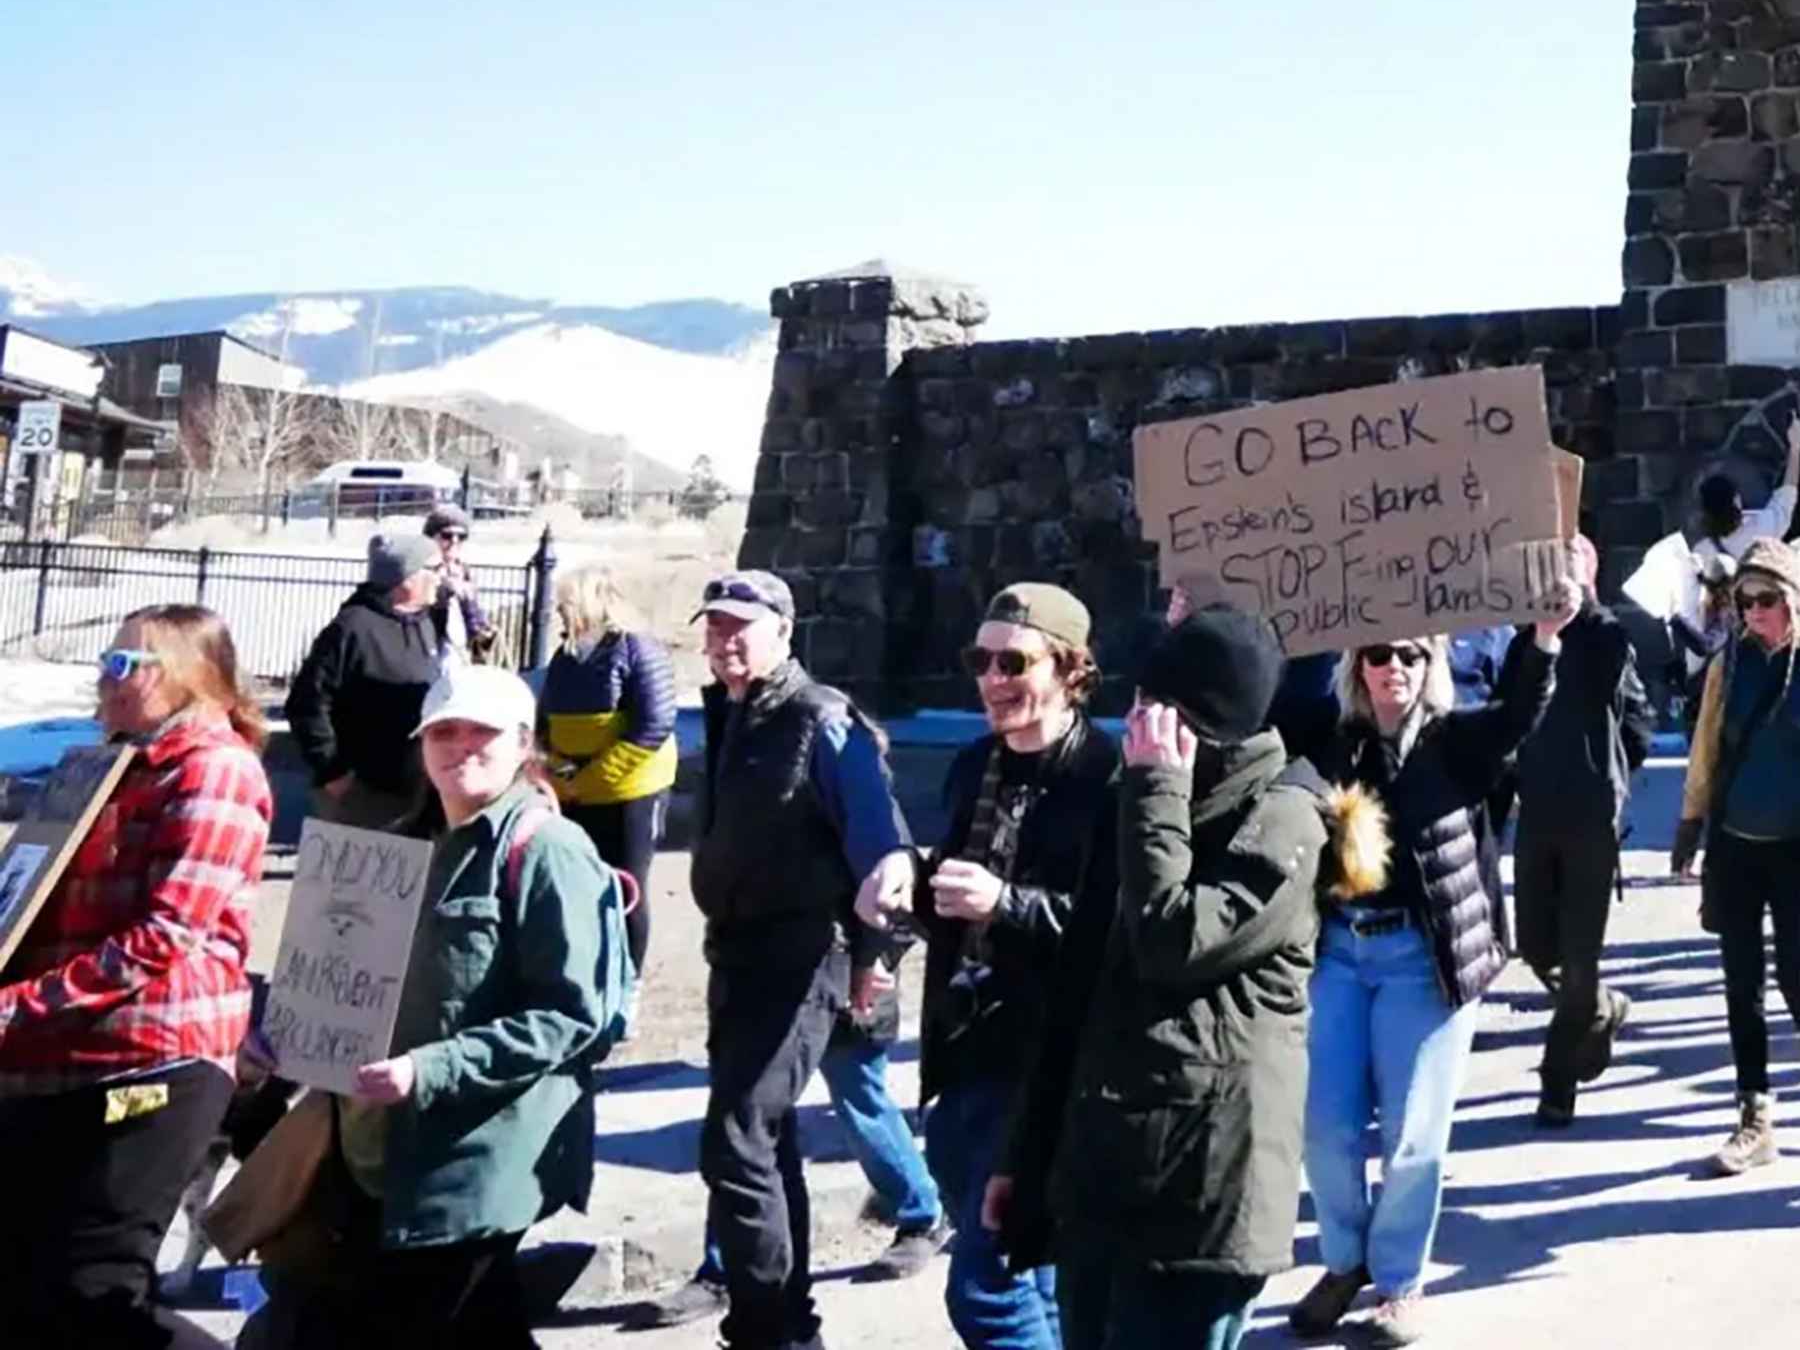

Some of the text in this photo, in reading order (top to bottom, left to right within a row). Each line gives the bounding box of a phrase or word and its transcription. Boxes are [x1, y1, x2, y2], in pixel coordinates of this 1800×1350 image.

[21, 427, 53, 447] 20
[1183, 397, 1515, 487] GO BACK to
[1221, 542, 1327, 613] STOP
